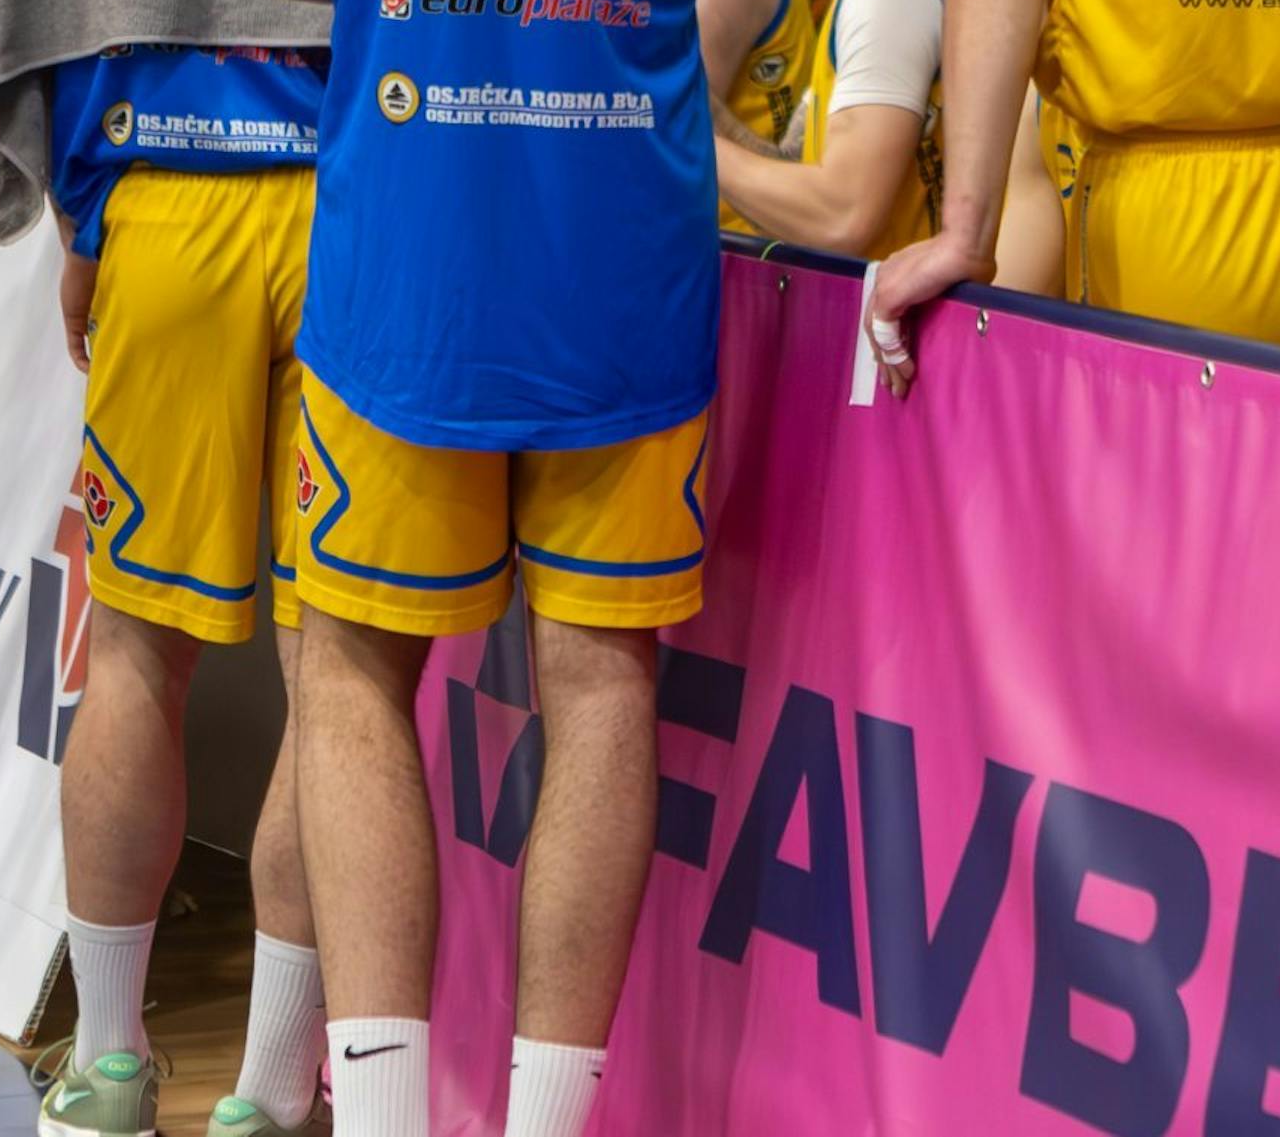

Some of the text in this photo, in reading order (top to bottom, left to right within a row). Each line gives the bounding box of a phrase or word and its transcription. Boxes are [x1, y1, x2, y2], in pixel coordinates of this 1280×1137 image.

[425, 82, 525, 107] OSJEČKA
[530, 89, 607, 111] ROBNA
[136, 113, 226, 136] OSJEČKA
[229, 118, 300, 139] ROBNA
[425, 108, 485, 125] OSIJEK
[488, 112, 592, 129] COMMODITY
[136, 134, 190, 150] OSIJEK
[193, 137, 288, 154] COMMODITY
